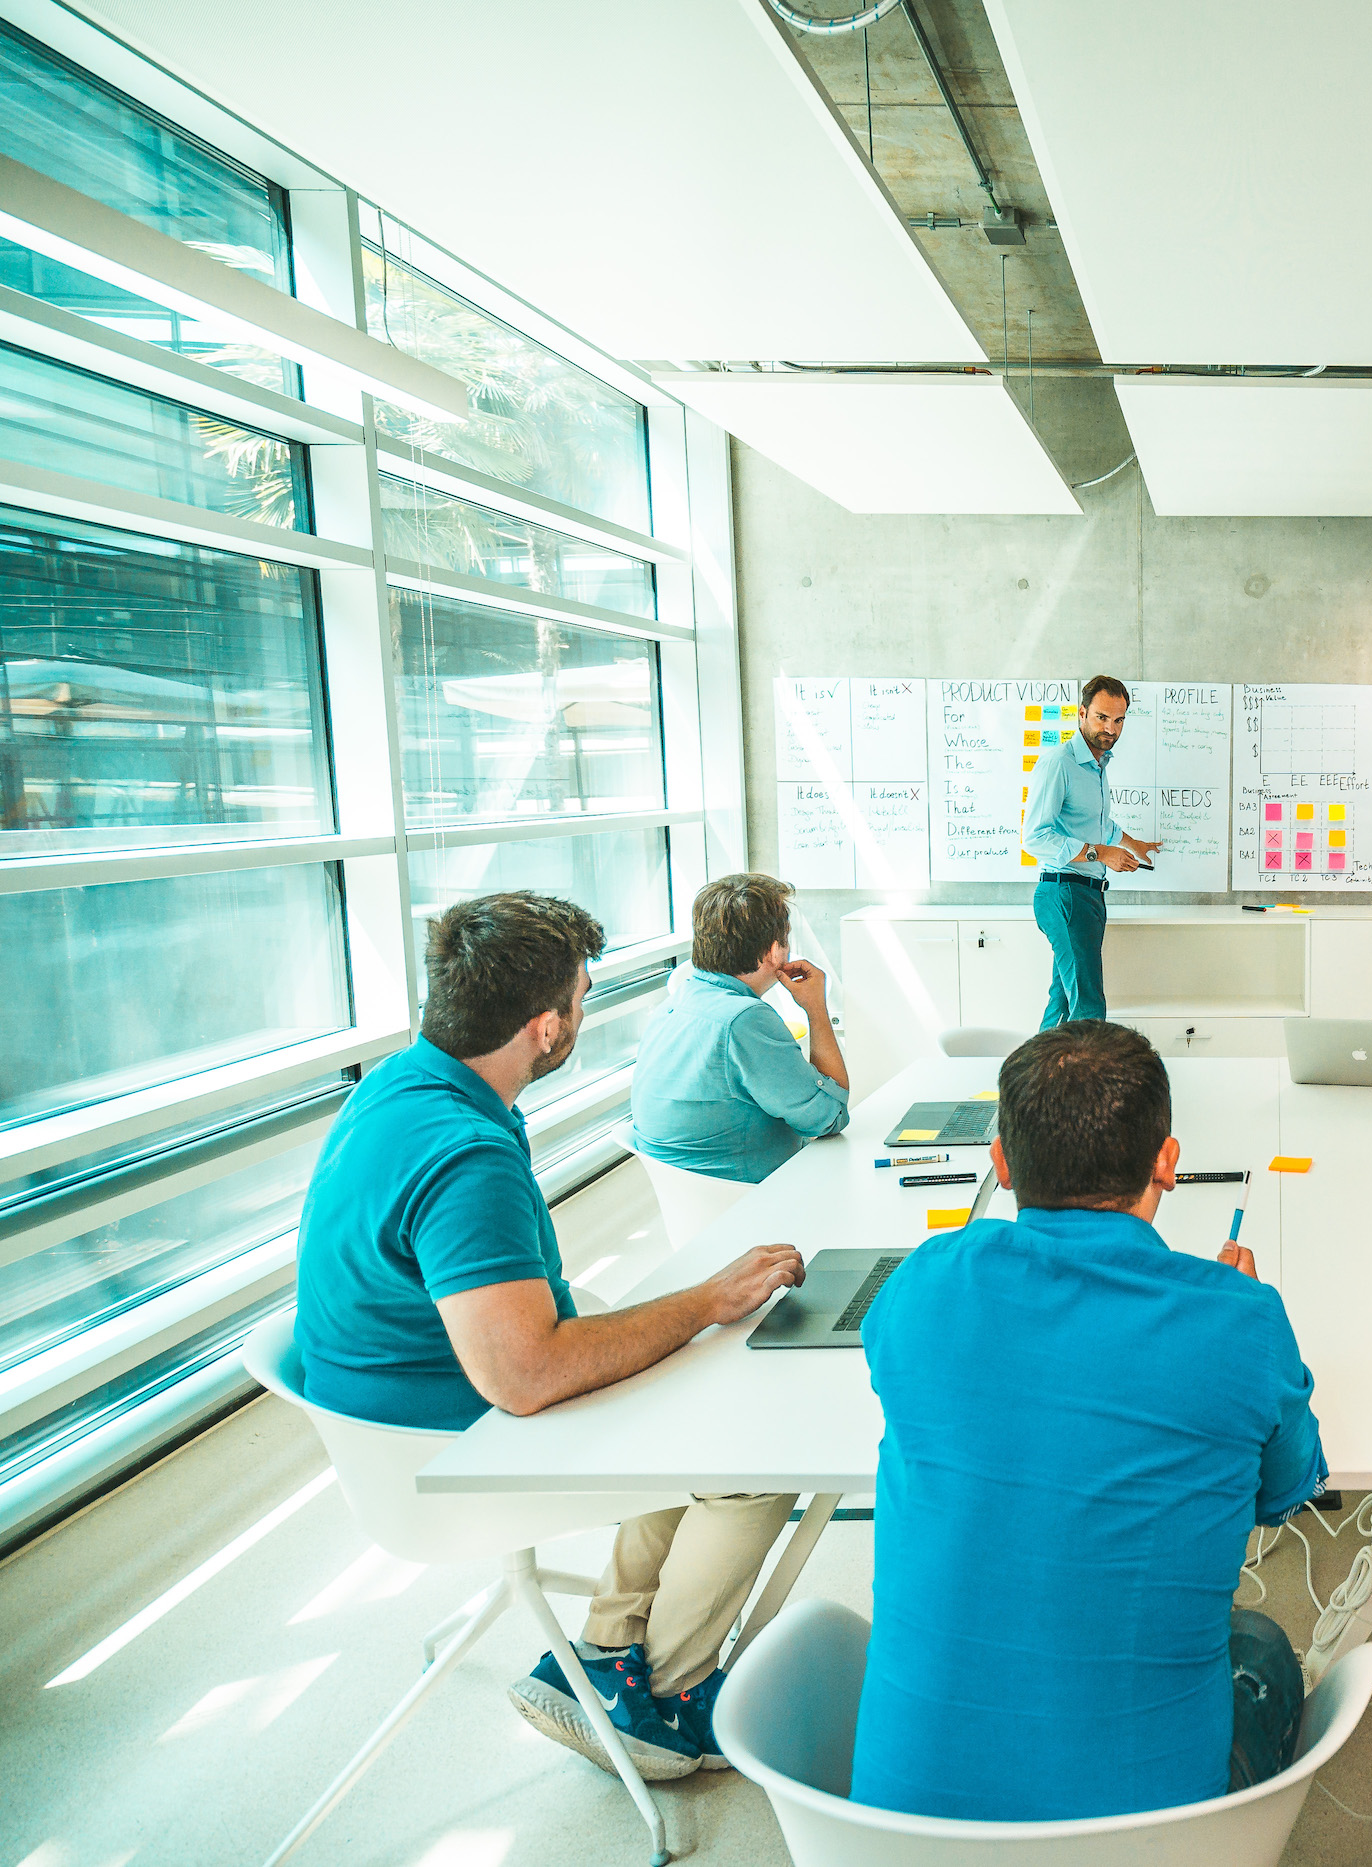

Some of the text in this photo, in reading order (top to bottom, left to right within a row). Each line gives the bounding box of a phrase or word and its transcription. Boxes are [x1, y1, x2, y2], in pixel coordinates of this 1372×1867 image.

[795, 683, 806, 700] It
[869, 684, 878, 696] It
[941, 681, 1071, 702] PRODUCT VISION
[1164, 688, 1219, 704] PROFILE
[1243, 684, 1282, 694] Business
[944, 705, 965, 724] For
[944, 733, 989, 748] Whose
[943, 755, 974, 769] The
[944, 780, 974, 794] Is a
[1340, 776, 1369, 791] Effort
[806, 786, 830, 800] does
[1109, 789, 1150, 806] AVIOR
[1161, 789, 1212, 808] NEEDS
[944, 800, 975, 814] That
[1239, 802, 1257, 811] BA3
[947, 822, 1019, 836] Different from
[1239, 827, 1255, 836] BA2
[947, 844, 1009, 860] Our product
[1239, 850, 1255, 859] BA1
[1353, 861, 1372, 871] Tech
